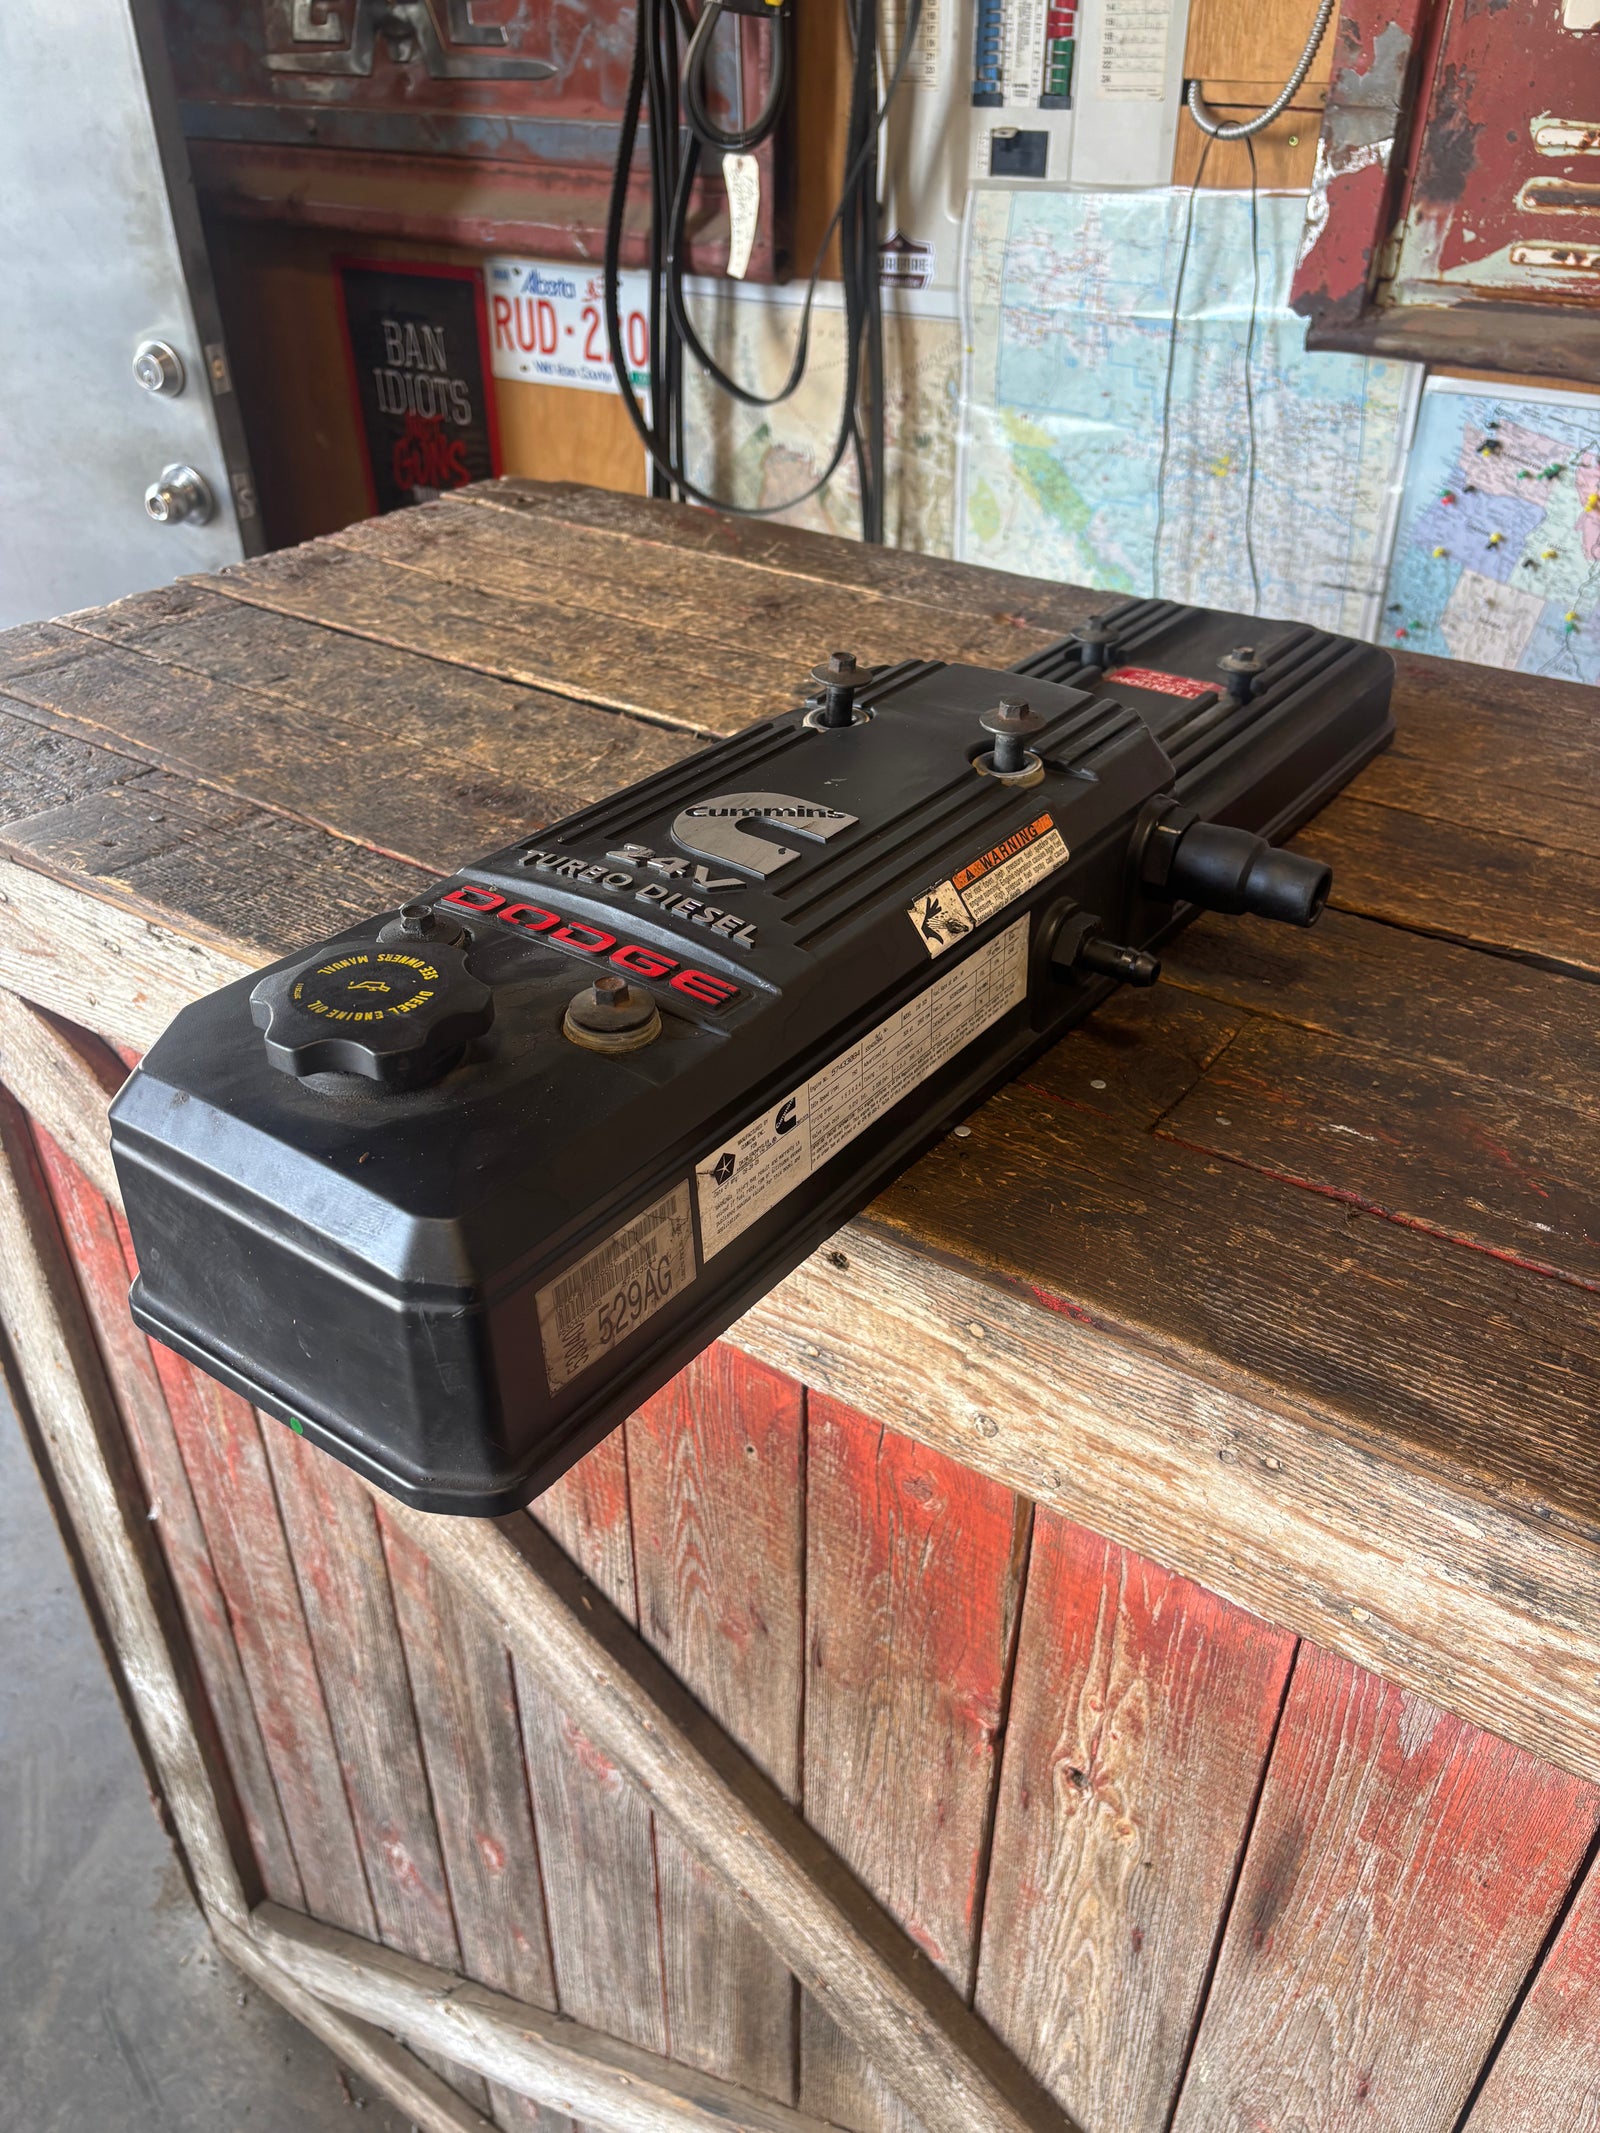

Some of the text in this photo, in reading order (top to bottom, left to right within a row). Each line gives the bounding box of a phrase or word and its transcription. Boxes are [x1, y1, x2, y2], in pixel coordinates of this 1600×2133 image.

[381, 319, 448, 373] BAN
[372, 367, 473, 427] IDIOTS
[392, 434, 472, 490] GUNS
[684, 804, 848, 820] Cummins
[605, 842, 748, 894] 24V
[979, 825, 1039, 870] WARNING
[517, 848, 758, 950] TURBO DIESEL
[316, 953, 440, 981] SEE OWNERS MANUAL
[440, 884, 742, 1010] DODGE
[305, 990, 434, 1021] DIESEL ENGINE OIL
[596, 1257, 673, 1345] 529AG
[561, 1319, 589, 1377] 53040
